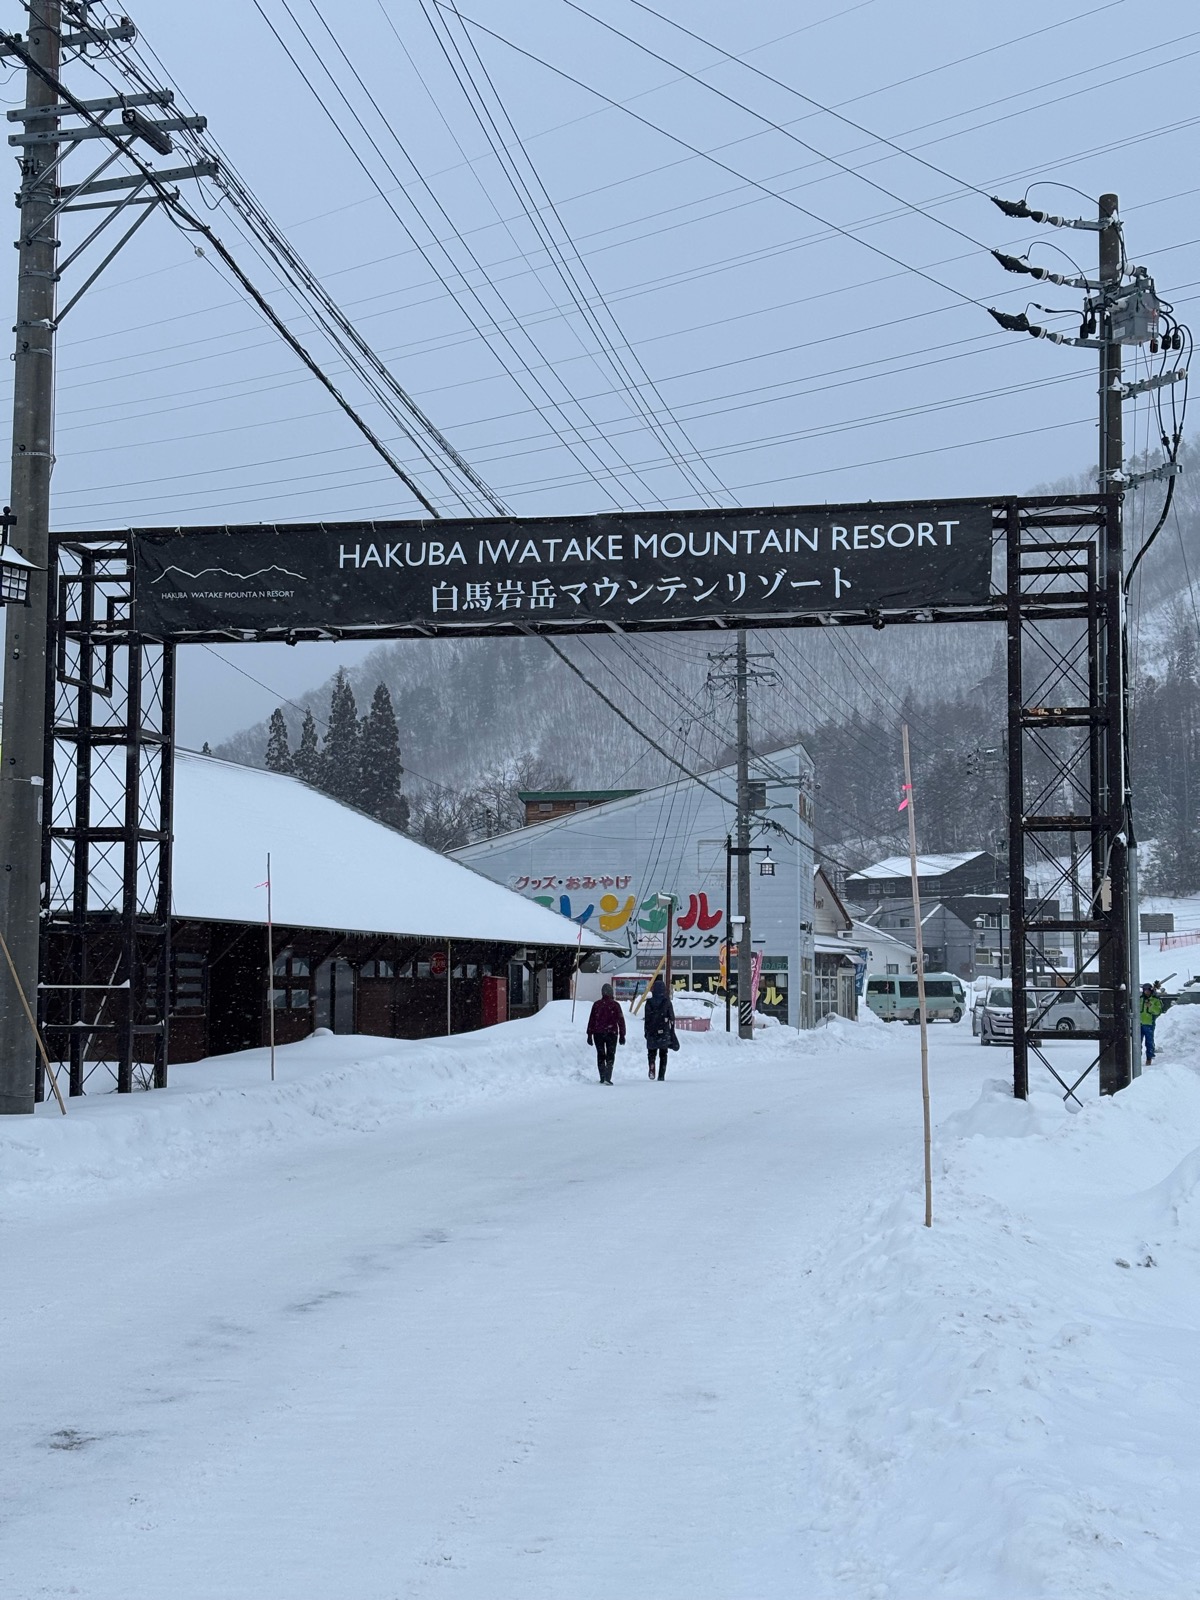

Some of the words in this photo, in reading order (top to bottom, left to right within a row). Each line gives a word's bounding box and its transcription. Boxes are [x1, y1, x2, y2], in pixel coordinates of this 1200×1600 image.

[338, 541, 467, 569] HAKUBA
[478, 535, 624, 565] IWATAKE
[633, 528, 819, 559] MOUNTAIN
[831, 519, 960, 552] RESORT
[161, 592, 188, 600] HAKUBA
[190, 591, 223, 599] WATAKE
[224, 590, 265, 599] MOUNTAN
[266, 590, 295, 598] RESORT
[431, 567, 853, 613] 白馬岩岳マウンテンリゾート
[515, 874, 633, 891] グッズ・おみやげ
[532, 890, 724, 933] レンタル
